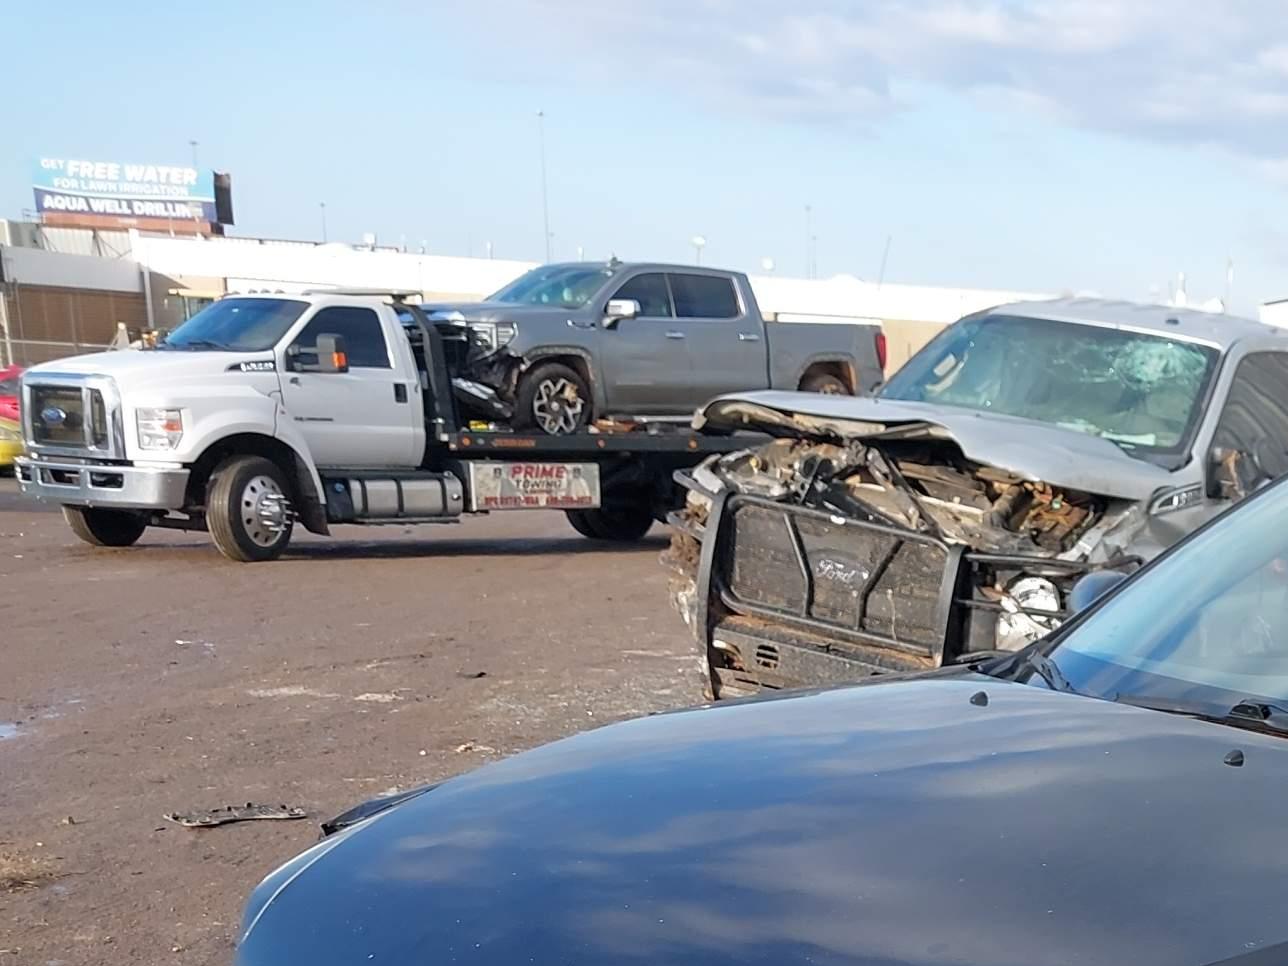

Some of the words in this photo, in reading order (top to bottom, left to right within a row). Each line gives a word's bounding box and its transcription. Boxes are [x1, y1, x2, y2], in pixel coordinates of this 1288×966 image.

[41, 159, 64, 169] GET
[67, 160, 120, 180] FREE
[124, 164, 197, 185] WATER
[54, 178, 78, 190] FOR
[80, 179, 117, 192] LAWN
[120, 183, 189, 196] IRRIGATION
[43, 194, 87, 210] AQUA
[89, 198, 131, 214] WELL
[133, 202, 203, 218] DRILLIN
[511, 464, 566, 479] PRIME
[515, 479, 561, 489] TOWING
